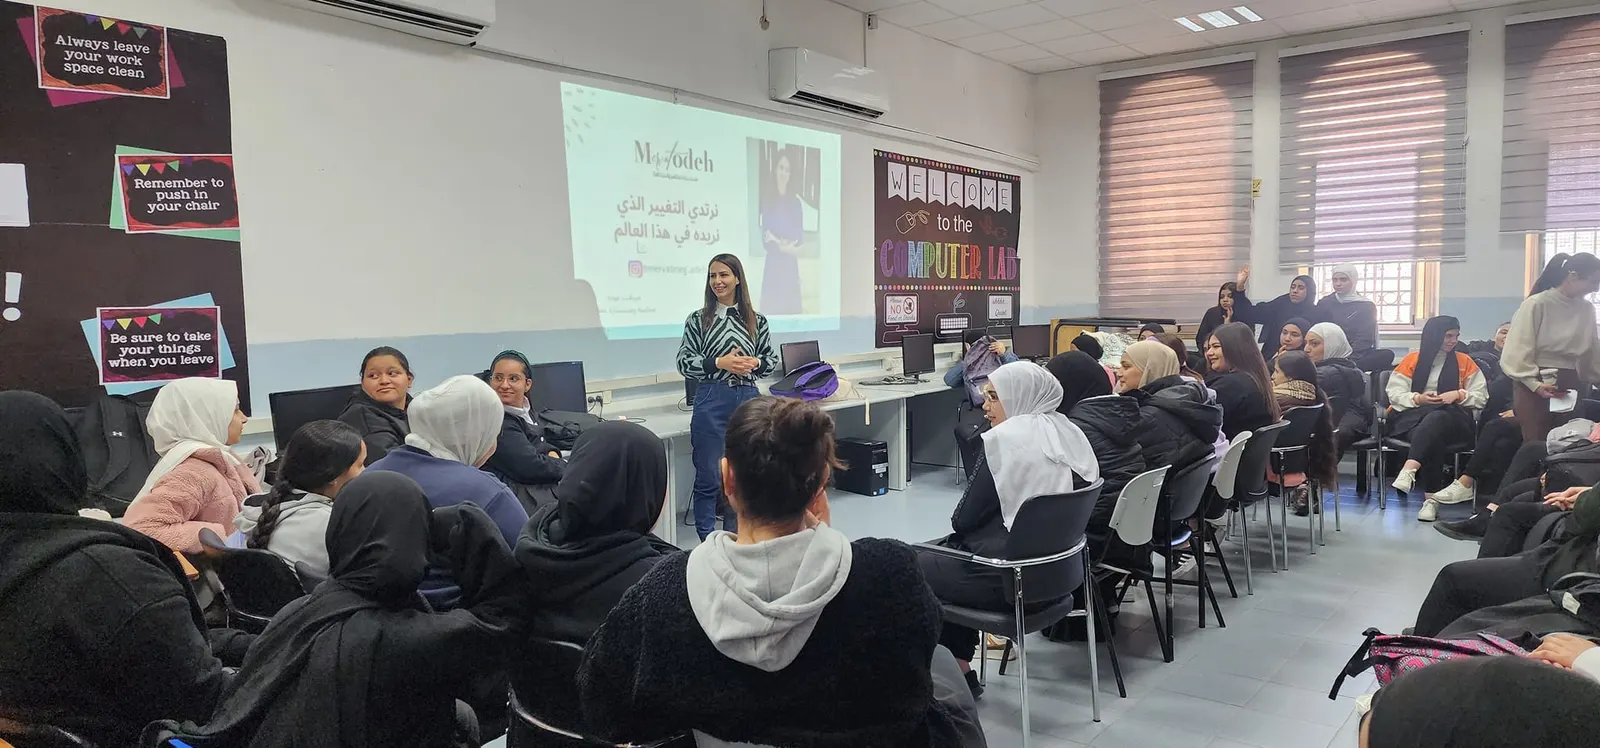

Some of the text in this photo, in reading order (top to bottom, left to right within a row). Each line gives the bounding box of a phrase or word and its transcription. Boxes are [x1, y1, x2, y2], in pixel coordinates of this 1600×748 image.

[55, 35, 150, 54] Always leave
[64, 51, 143, 66] your work
[63, 63, 145, 78] space clean
[134, 178, 225, 189] Remember to
[891, 171, 1009, 206] WELCOME
[155, 188, 208, 201] push in
[147, 199, 220, 214] your chair
[617, 195, 719, 224] نرتدي التغيير الذي
[937, 213, 973, 233] to the
[614, 221, 648, 244] العالم
[651, 224, 671, 239] هذا
[674, 225, 691, 248] في
[880, 239, 1017, 280] COMPUTER LAB
[890, 304, 901, 315] NO
[110, 331, 212, 343] Be sure to take
[119, 343, 201, 357] your things
[108, 354, 214, 369] when you leave
